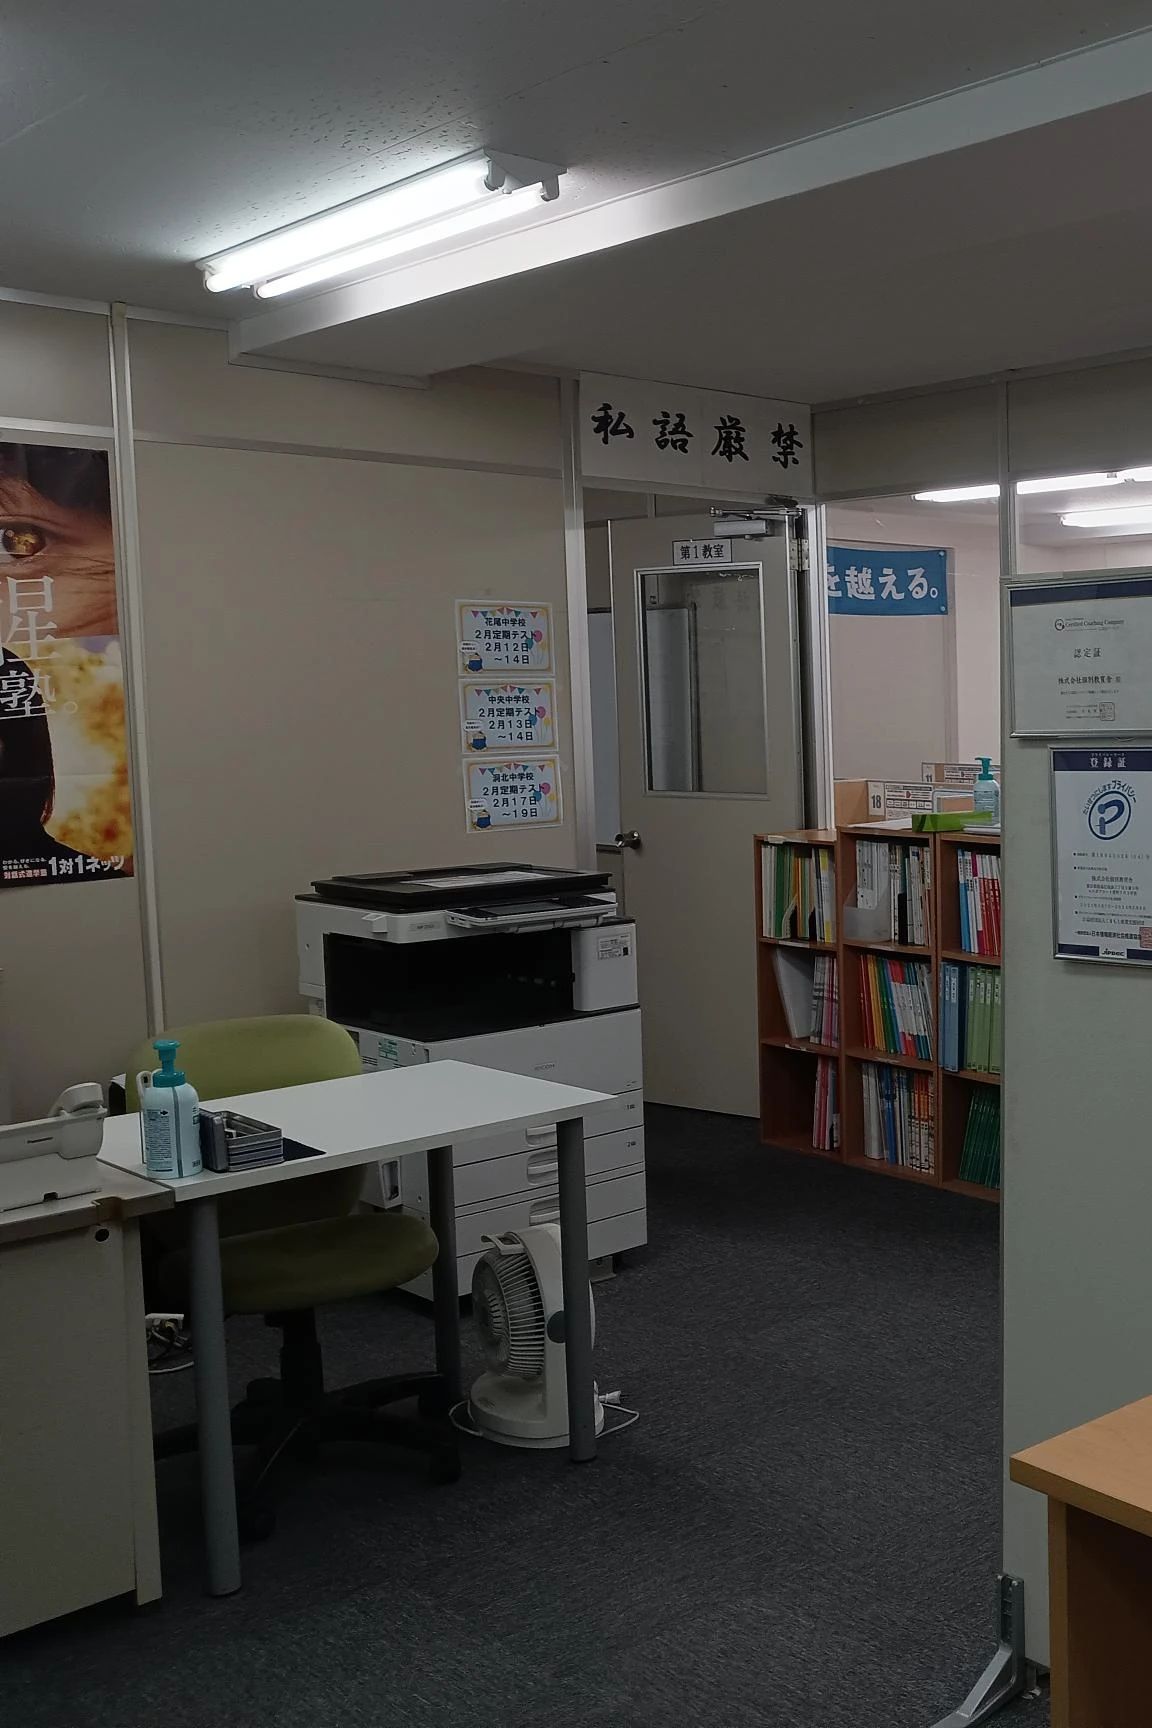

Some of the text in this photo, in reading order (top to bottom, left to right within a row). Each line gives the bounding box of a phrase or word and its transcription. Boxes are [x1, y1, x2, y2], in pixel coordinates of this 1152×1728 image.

[591, 402, 803, 468] 私語厳禁
[679, 543, 724, 560] 第1教室
[485, 617, 527, 627] 花尾中学校
[475, 629, 537, 640] 2月定期テスト
[485, 642, 530, 652] 2月12日
[488, 695, 530, 705] 中央中学校
[478, 706, 540, 718] 2月定期テスト
[488, 719, 533, 730] 2月13日
[1090, 757, 1127, 768] 登録証
[482, 783, 545, 796] 2月定期テスト
[493, 797, 537, 808] 2月17日
[871, 794, 882, 809] 18
[48, 854, 125, 876] 1対1ネッツ
